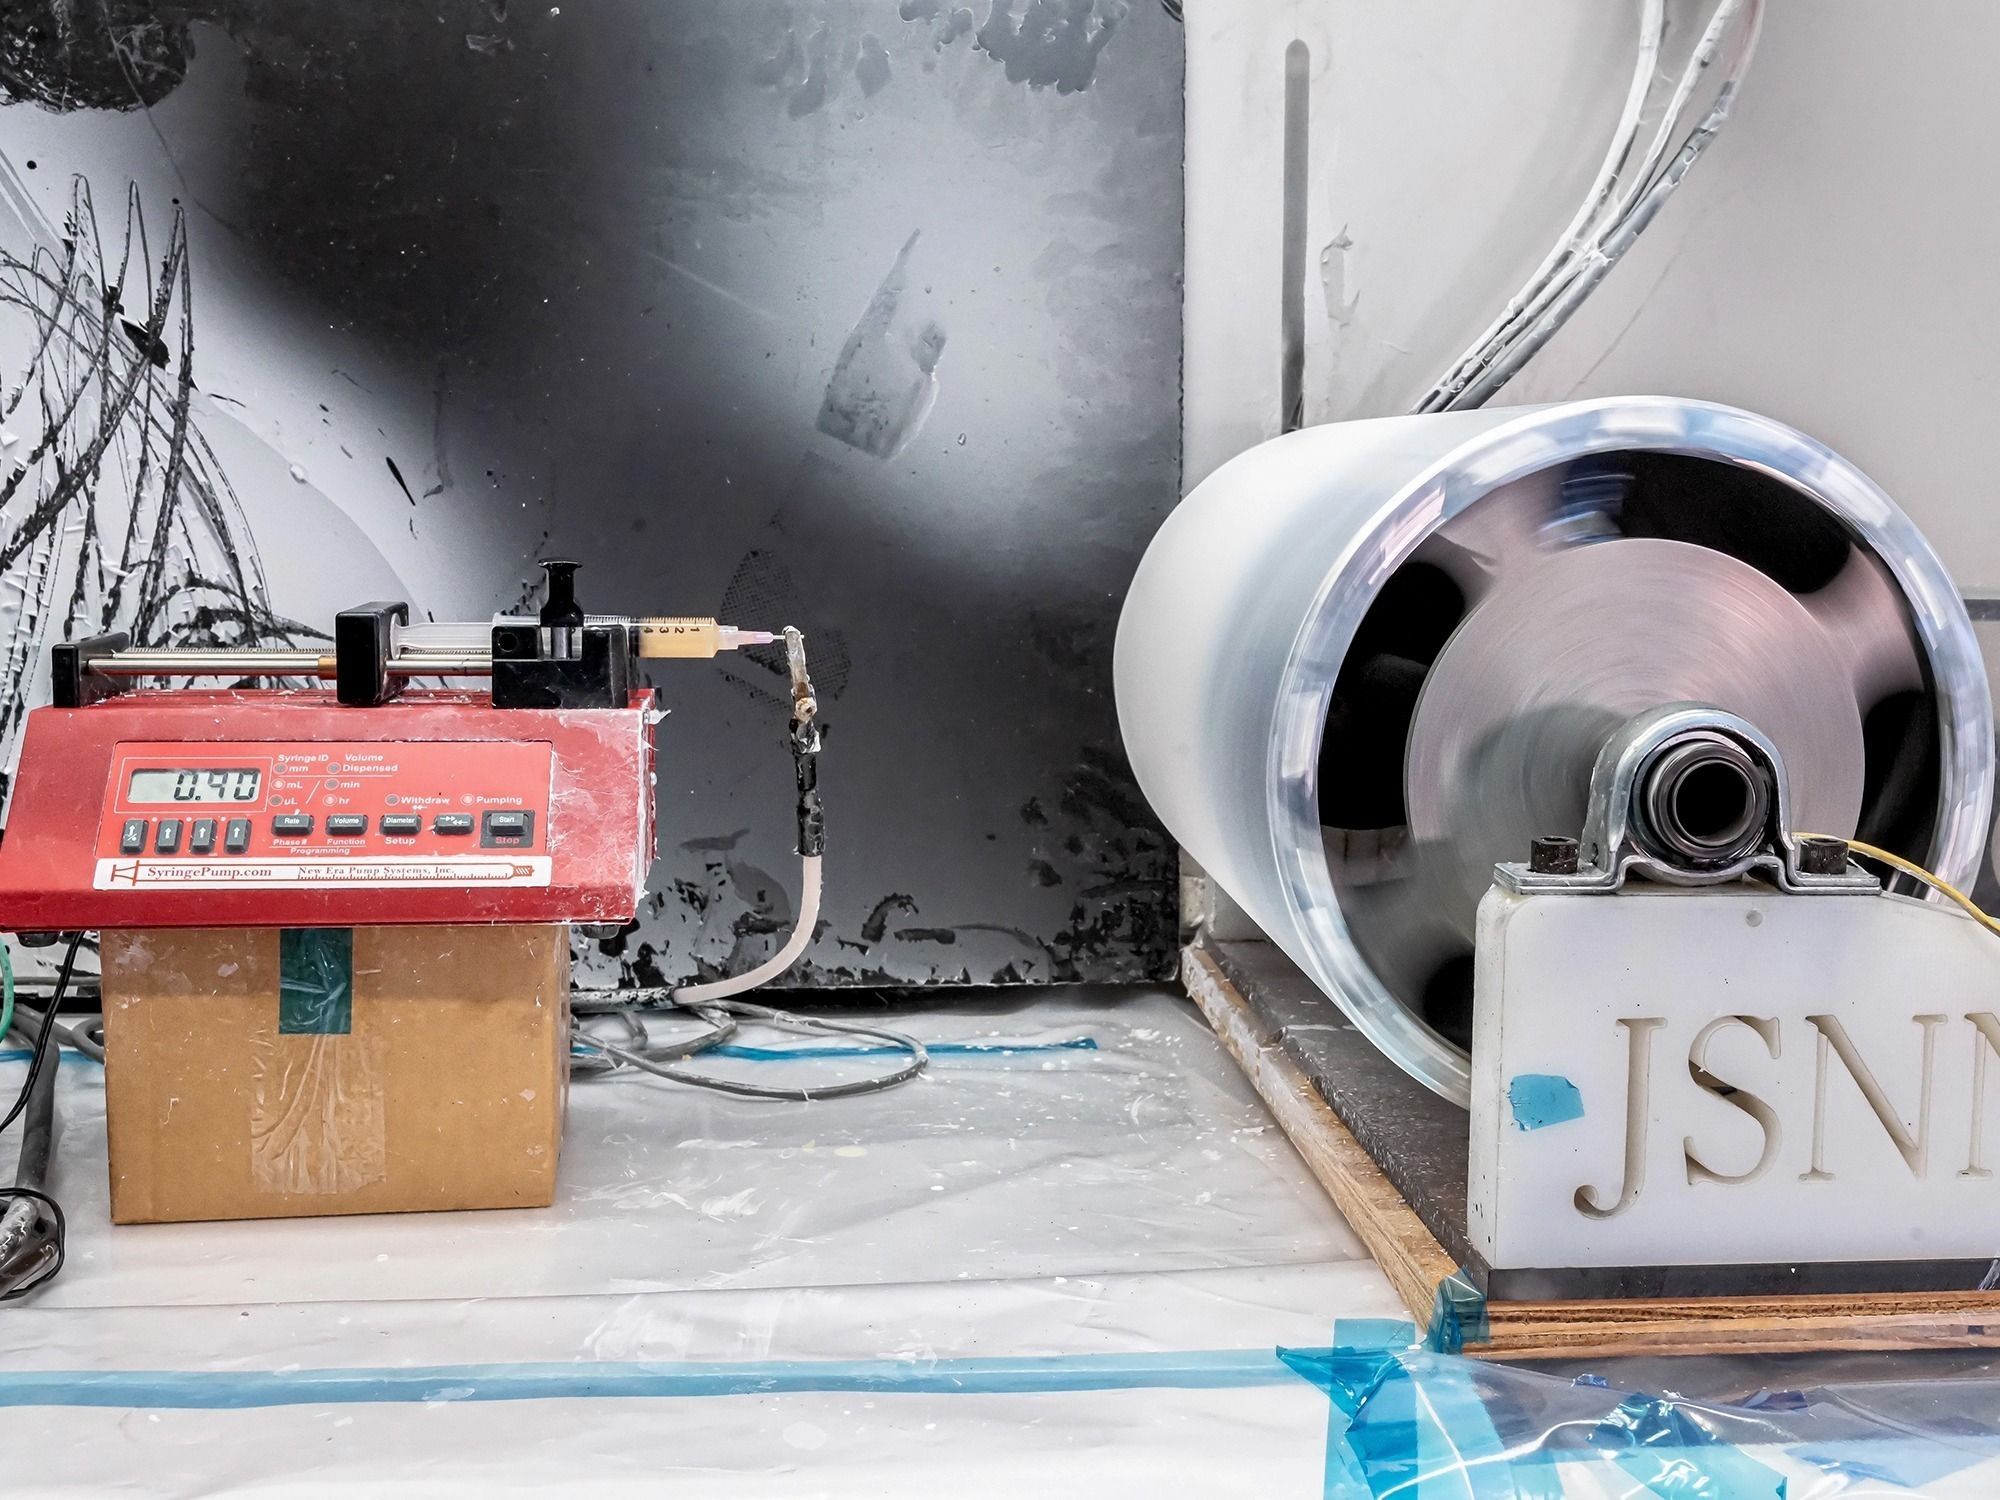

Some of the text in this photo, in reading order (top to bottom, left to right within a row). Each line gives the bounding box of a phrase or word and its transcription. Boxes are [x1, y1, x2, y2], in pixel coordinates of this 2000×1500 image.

[278, 754, 317, 763] Syringe
[345, 754, 384, 762] Volume
[342, 764, 398, 774] Dispensed
[173, 771, 259, 801] 0.40
[286, 781, 303, 789] mL
[340, 781, 360, 789] min
[338, 797, 350, 805] hr
[401, 796, 450, 805] Withdraw
[476, 796, 523, 805] Pumping
[284, 817, 300, 825] Rate
[334, 817, 360, 825] Volume
[499, 816, 515, 824] Start
[326, 838, 366, 846] Function
[385, 837, 416, 846] Setup
[495, 837, 520, 845] Stop
[290, 847, 350, 855] Programming
[147, 867, 272, 880] SyringePump.com
[298, 866, 455, 876] New Era Pump Systems, Inc.
